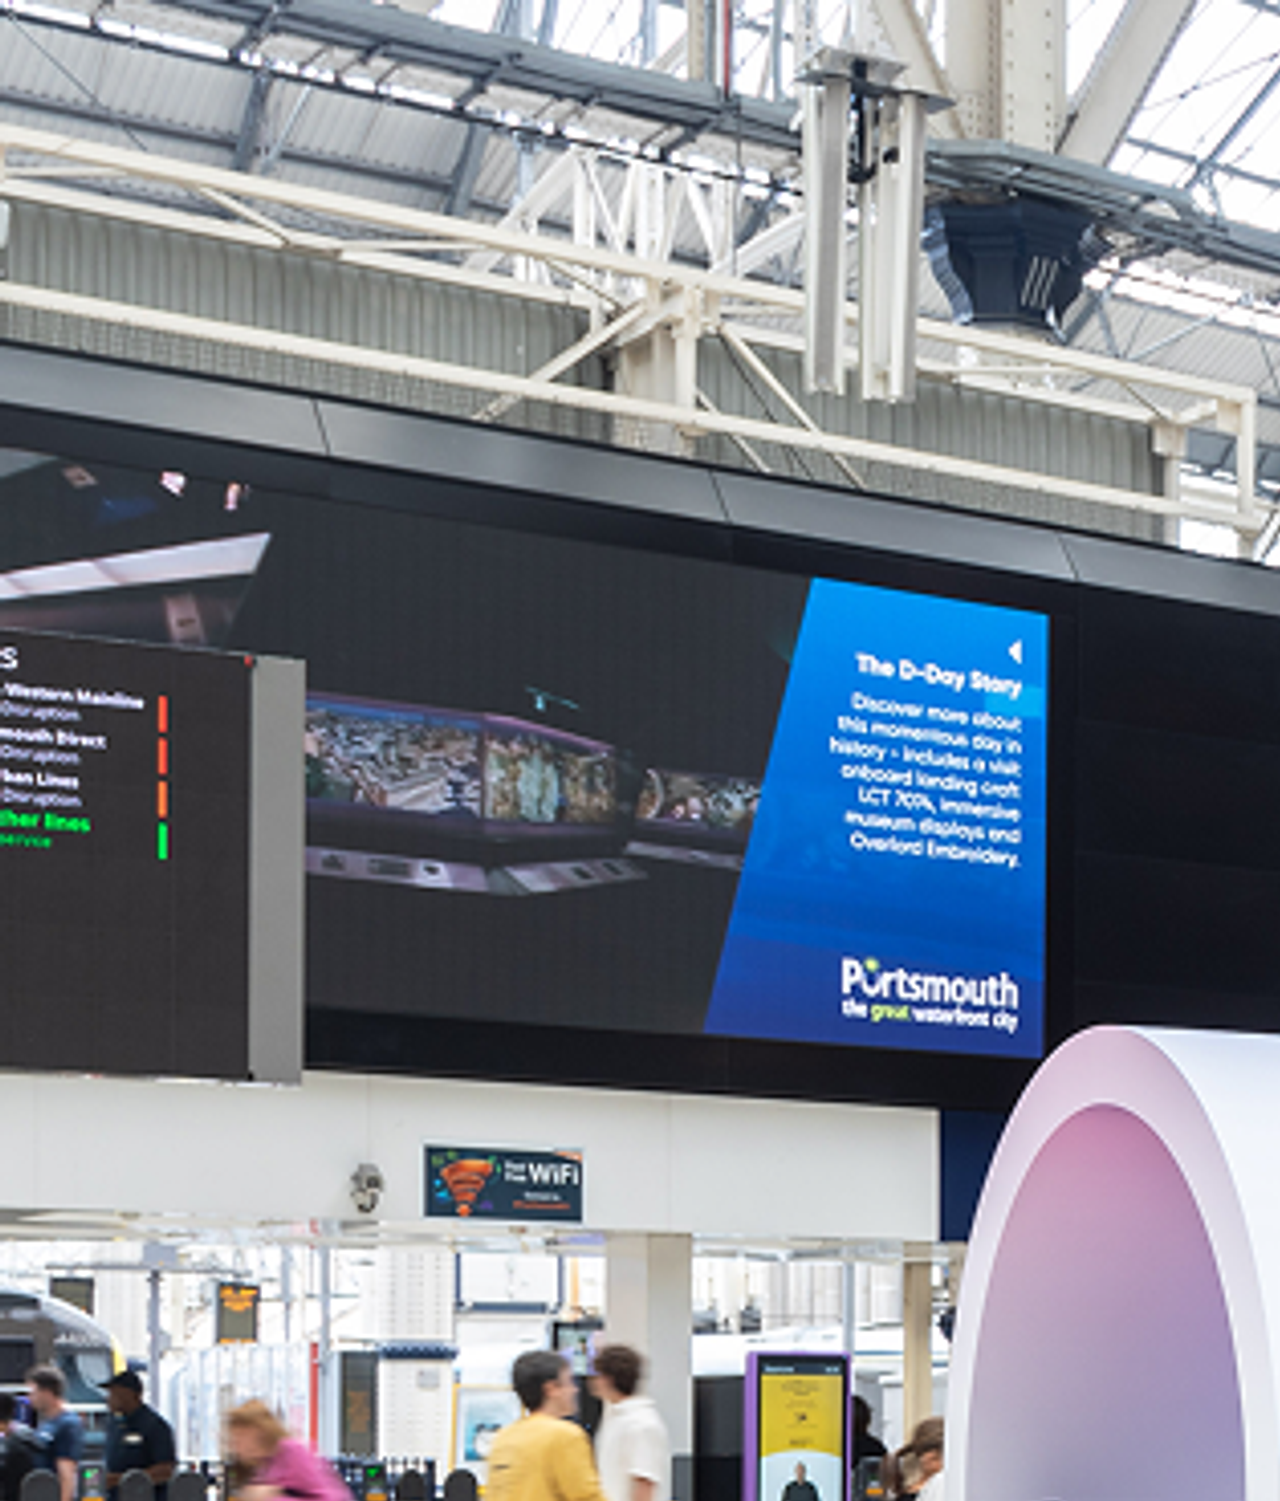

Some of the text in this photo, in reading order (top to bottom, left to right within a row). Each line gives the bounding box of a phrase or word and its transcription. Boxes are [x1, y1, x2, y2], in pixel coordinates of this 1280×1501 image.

[4, 682, 73, 701] Western
[856, 652, 1021, 700] The D-Day Story
[852, 691, 1021, 733] Discover more about
[838, 715, 1021, 754] this momentous day in
[830, 737, 886, 761] history
[903, 744, 968, 771] includes
[973, 757, 985, 773] a
[989, 757, 1021, 778] visit
[37, 772, 79, 790] Lines
[841, 764, 1021, 798] onboard landing craft
[858, 786, 891, 806] LCT
[940, 797, 1021, 822] immersive
[45, 812, 91, 834] lines
[845, 809, 1021, 843] museum displays and
[850, 830, 1021, 869] Overlord Embroidery.
[842, 957, 1018, 1009] Portsmouth
[842, 998, 1018, 1034] the great waterfront city
[528, 1162, 579, 1186] WiFi
